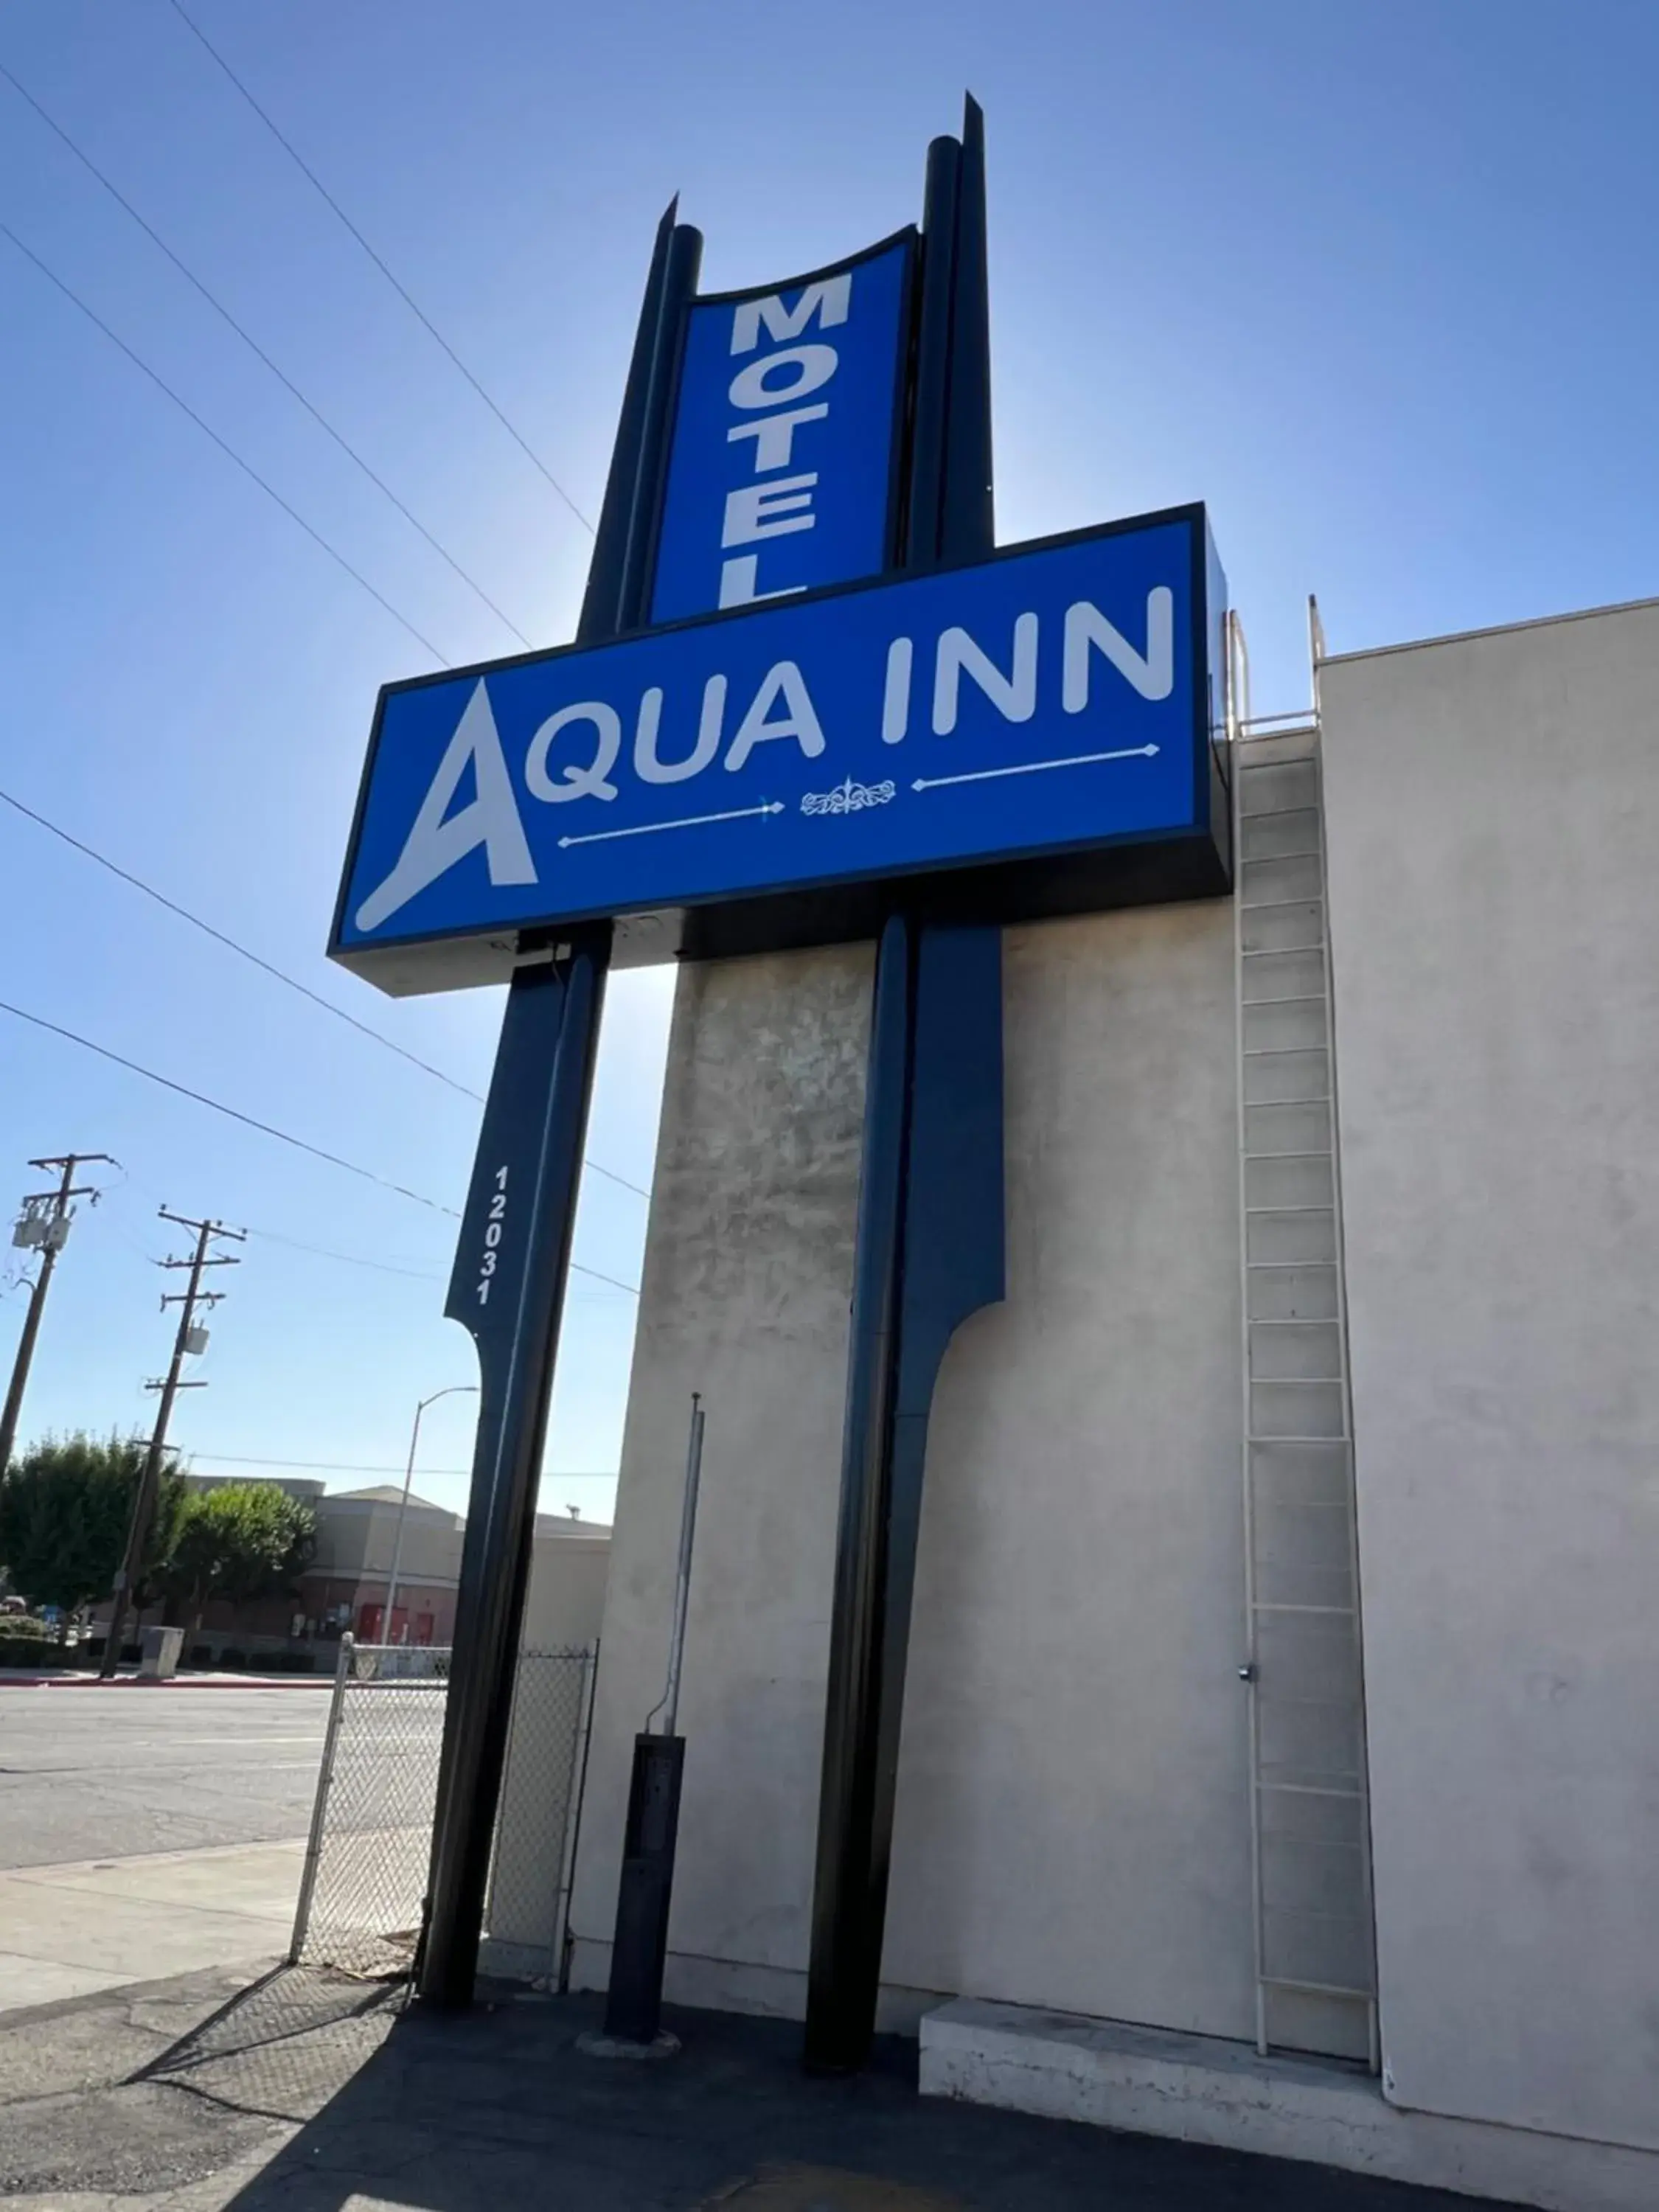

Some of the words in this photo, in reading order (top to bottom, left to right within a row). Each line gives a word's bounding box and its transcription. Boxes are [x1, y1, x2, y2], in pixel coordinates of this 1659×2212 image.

[718, 273, 852, 611] MOTEL
[355, 660, 826, 933] AQUA
[882, 585, 1174, 745] INN
[476, 1165, 509, 1305] 12031
